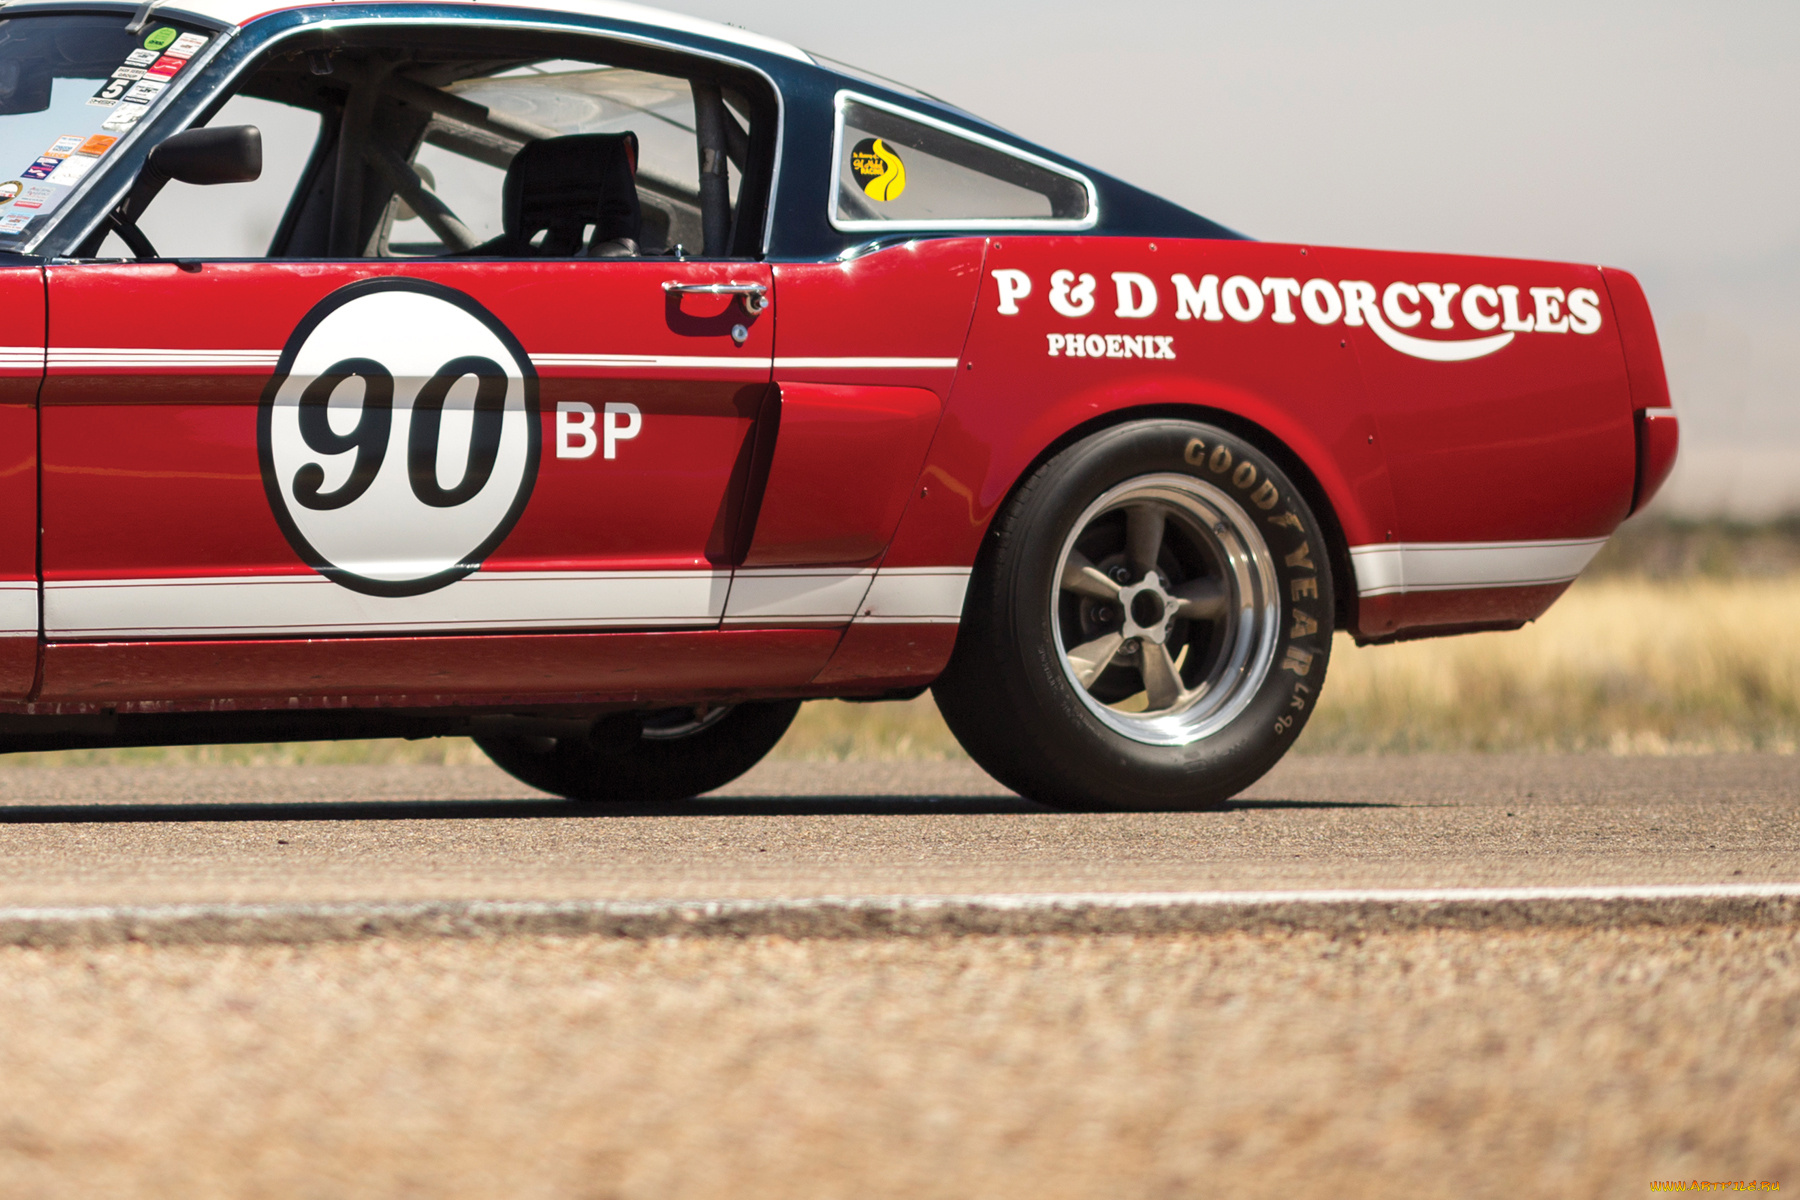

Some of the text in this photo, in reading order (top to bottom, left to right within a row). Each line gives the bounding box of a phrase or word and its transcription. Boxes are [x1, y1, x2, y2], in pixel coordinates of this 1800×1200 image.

[102, 79, 130, 99] 5
[991, 269, 1602, 362] P & D MOTORCYCLES
[1046, 333, 1177, 360] PHOENIX
[292, 355, 509, 511] 90
[555, 401, 643, 460] BP
